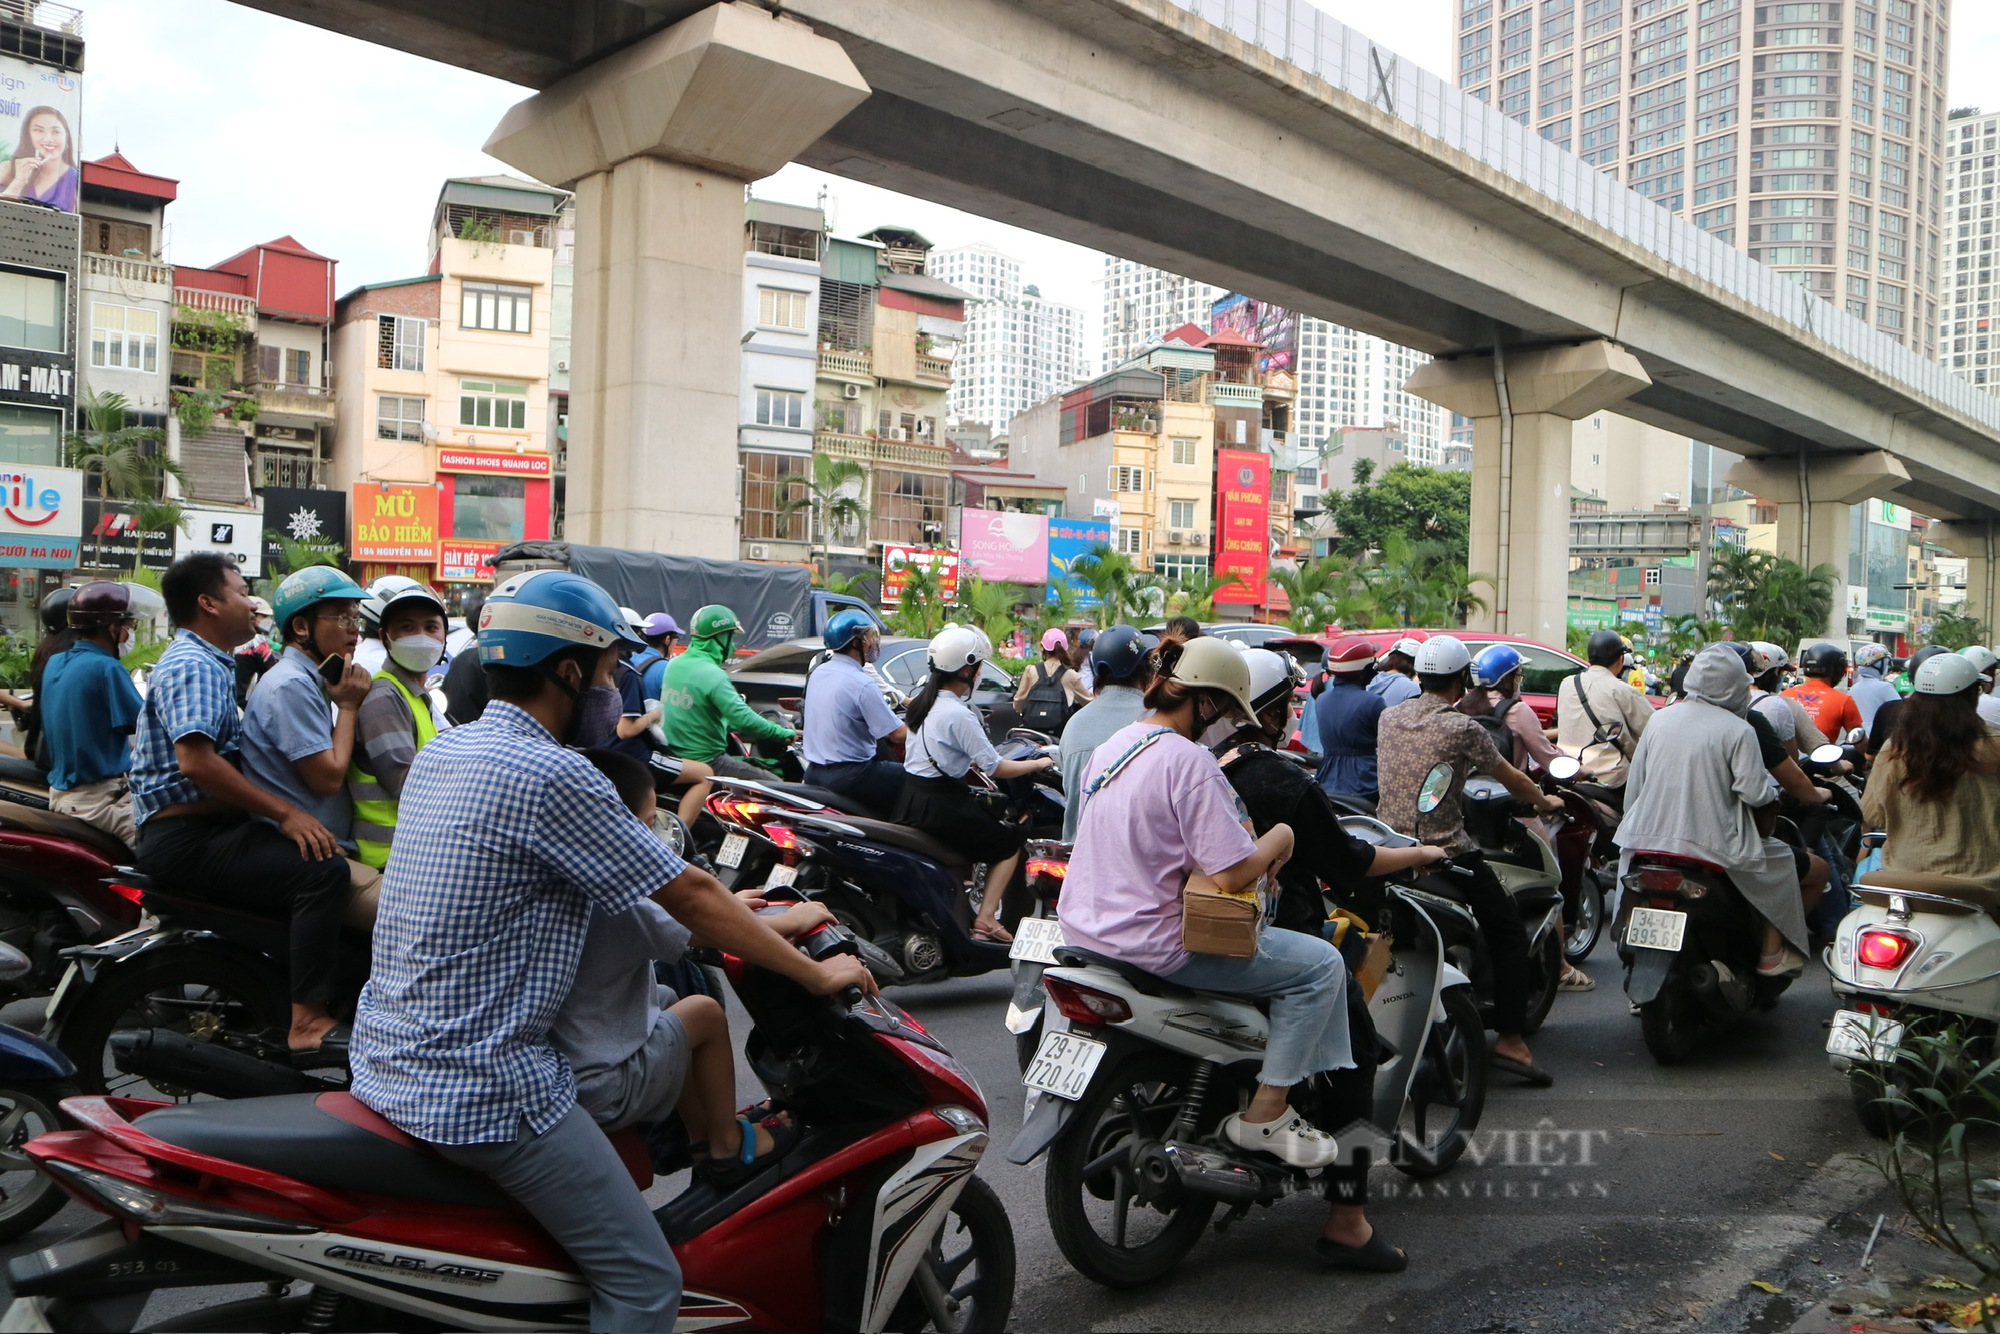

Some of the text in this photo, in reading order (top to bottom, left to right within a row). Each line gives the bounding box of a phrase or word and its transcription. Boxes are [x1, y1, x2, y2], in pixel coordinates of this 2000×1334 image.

[40, 73, 75, 89] smile
[442, 454, 475, 467] FASHION
[476, 457, 500, 468] SHOES
[501, 458, 530, 469] QUANG
[375, 490, 416, 518] MŨ
[358, 517, 432, 543] BẢO HIỂM
[376, 546, 411, 557] NGUYỄN
[443, 549, 462, 565] GIÀY
[464, 550, 479, 567] DÉP
[711, 616, 730, 628] Grab
[661, 687, 693, 710] rab
[1631, 928, 1680, 948] 395.66
[1382, 992, 1416, 1005] HONDA
[1072, 1028, 1093, 1037] HONDA
[1045, 1036, 1094, 1067] 29-T1
[1028, 1060, 1087, 1095] 720.40
[324, 1245, 504, 1283] AIR BLADE
[345, 1261, 483, 1288] PREMIUM SPORT EDITION
